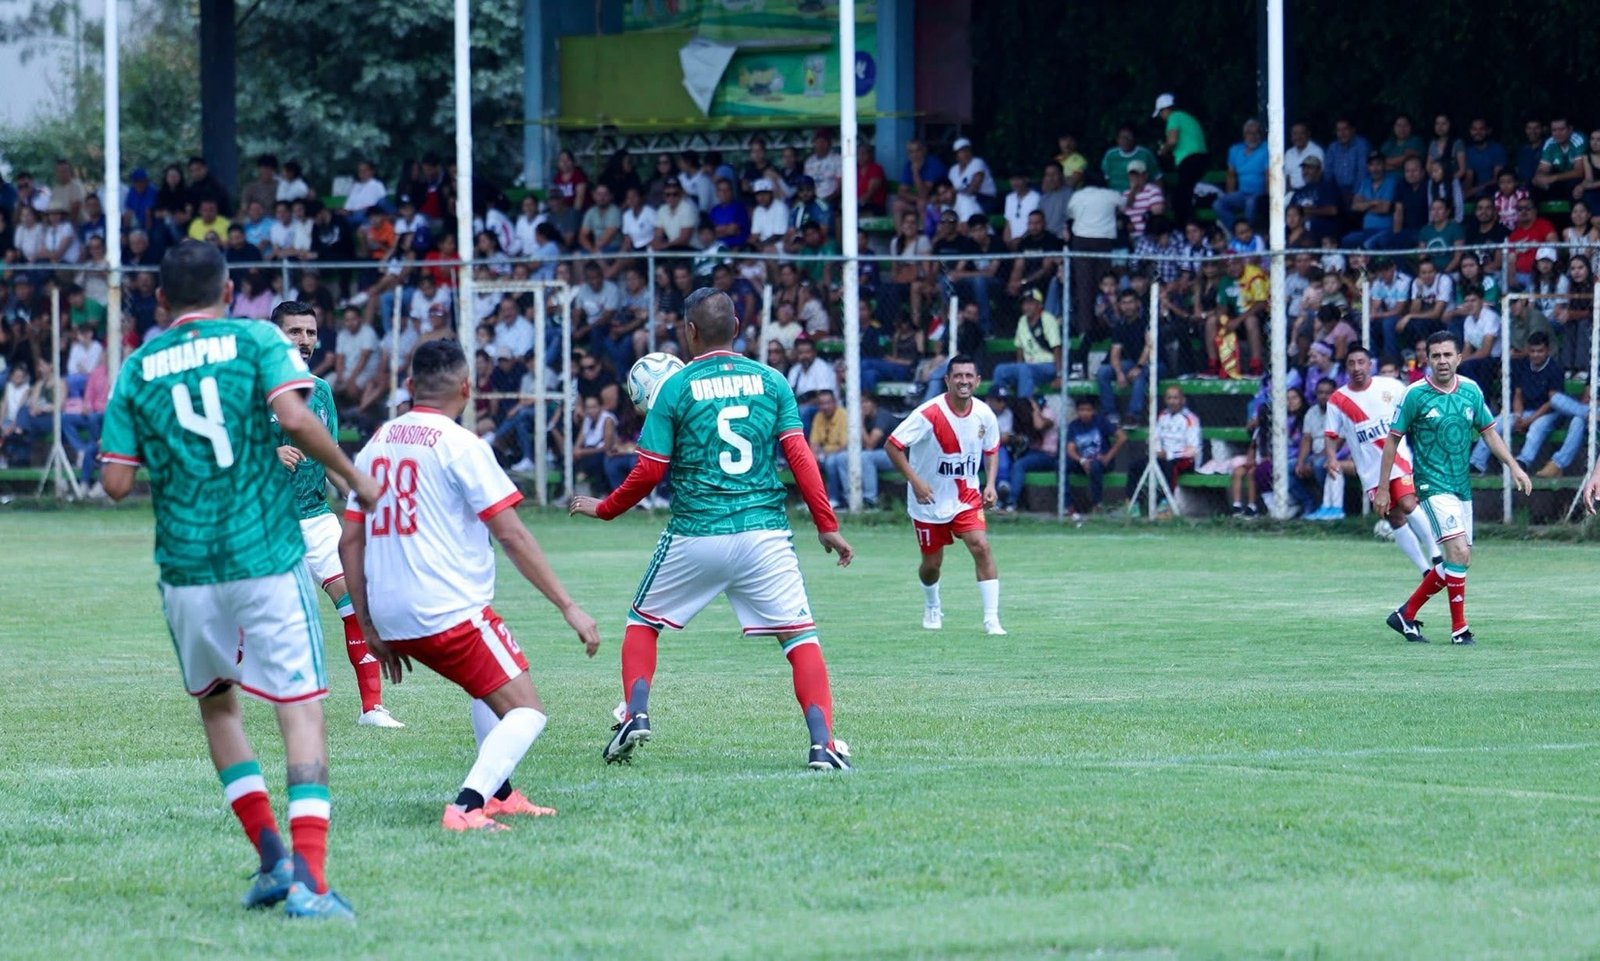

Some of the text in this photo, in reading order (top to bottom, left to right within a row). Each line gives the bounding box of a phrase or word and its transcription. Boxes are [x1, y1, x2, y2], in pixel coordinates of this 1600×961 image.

[142, 335, 237, 381] URUAPAN
[690, 375, 765, 401] URUAPAN
[171, 376, 234, 469] 4
[386, 424, 442, 447] SANSORES
[717, 405, 753, 475] 5
[371, 456, 418, 537] 28
